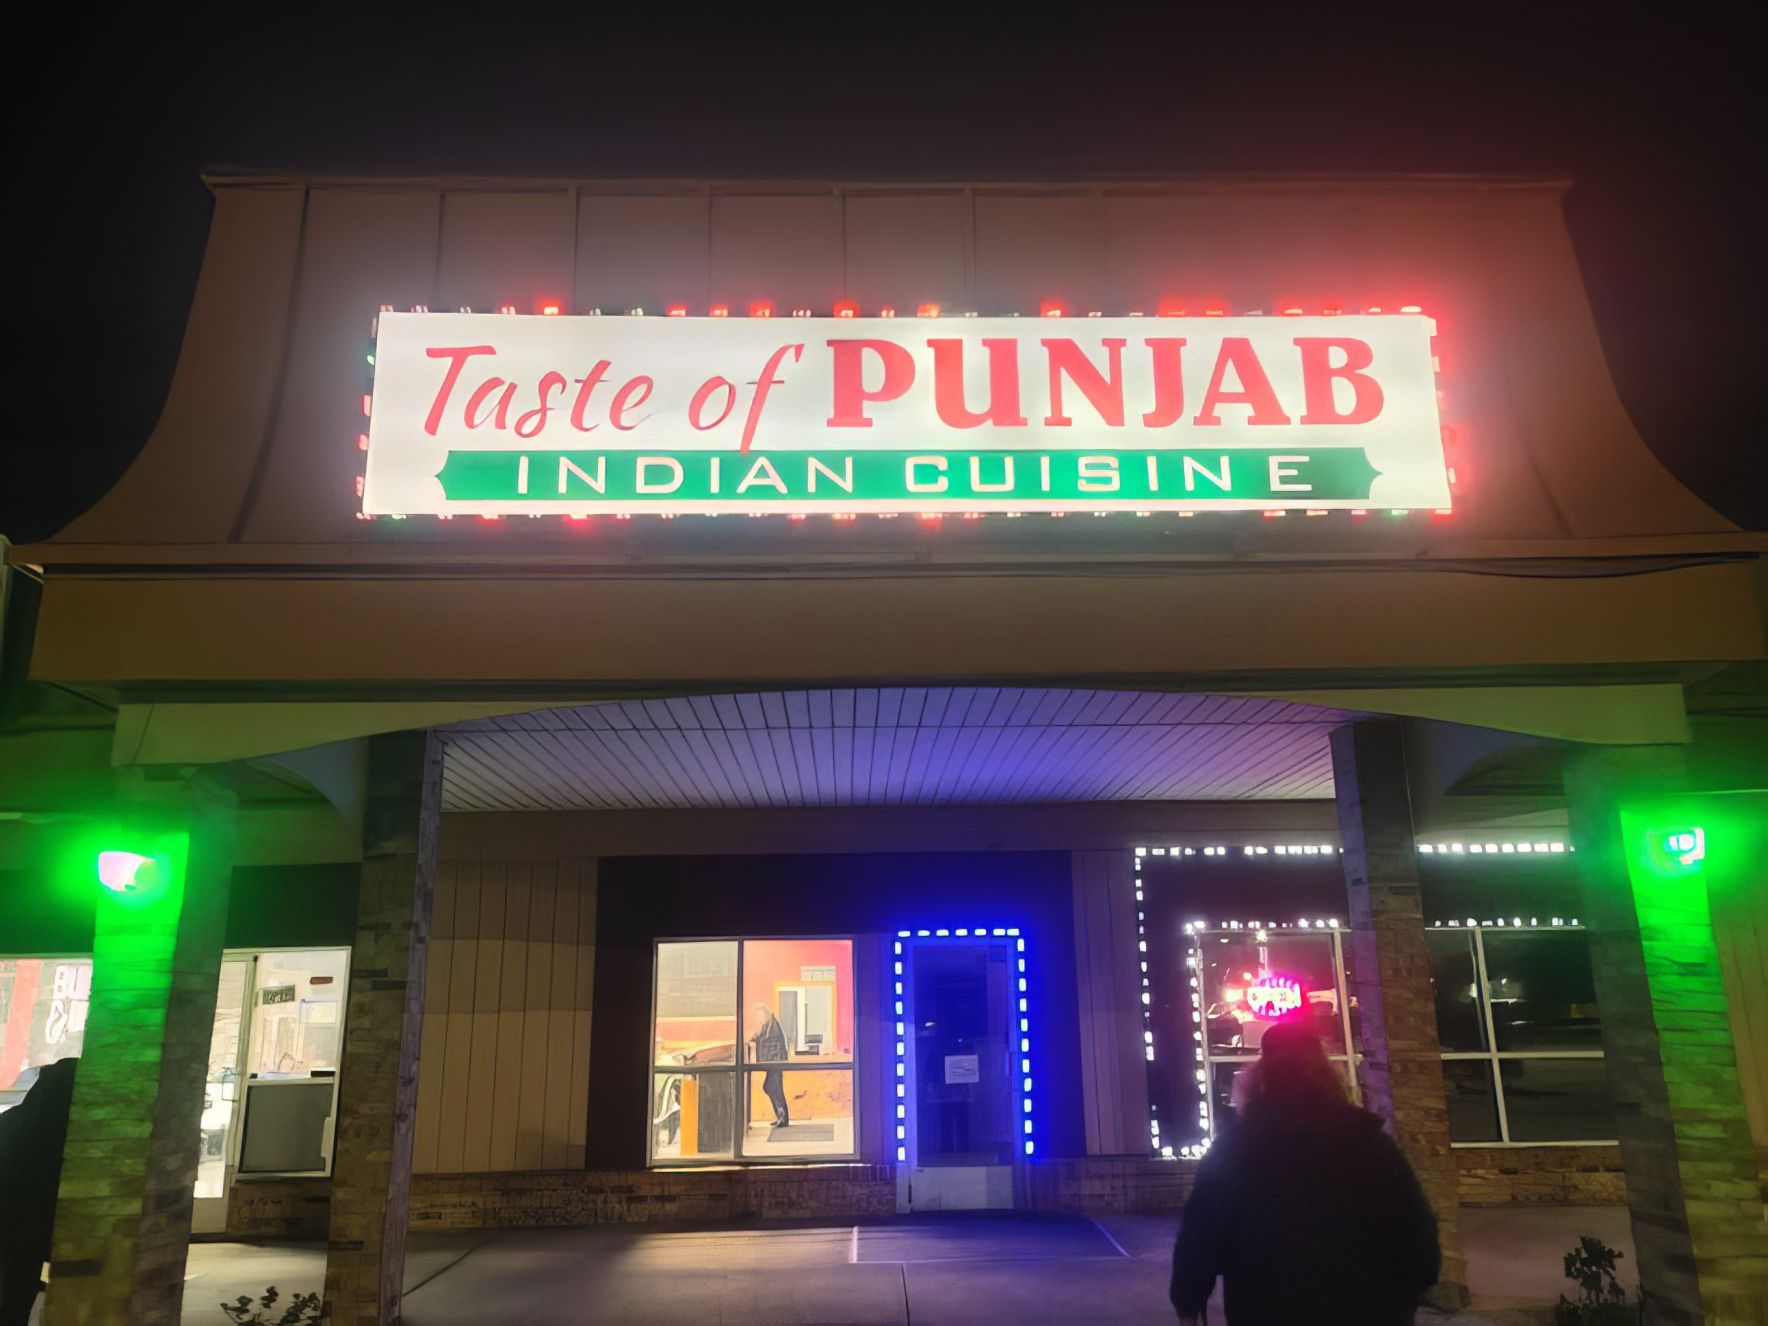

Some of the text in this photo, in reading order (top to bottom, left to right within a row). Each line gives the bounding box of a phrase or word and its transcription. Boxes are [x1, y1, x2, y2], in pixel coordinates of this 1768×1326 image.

[424, 336, 1385, 455] Taste of PUNJAB
[516, 454, 1313, 495] INDIAN CUISINE
